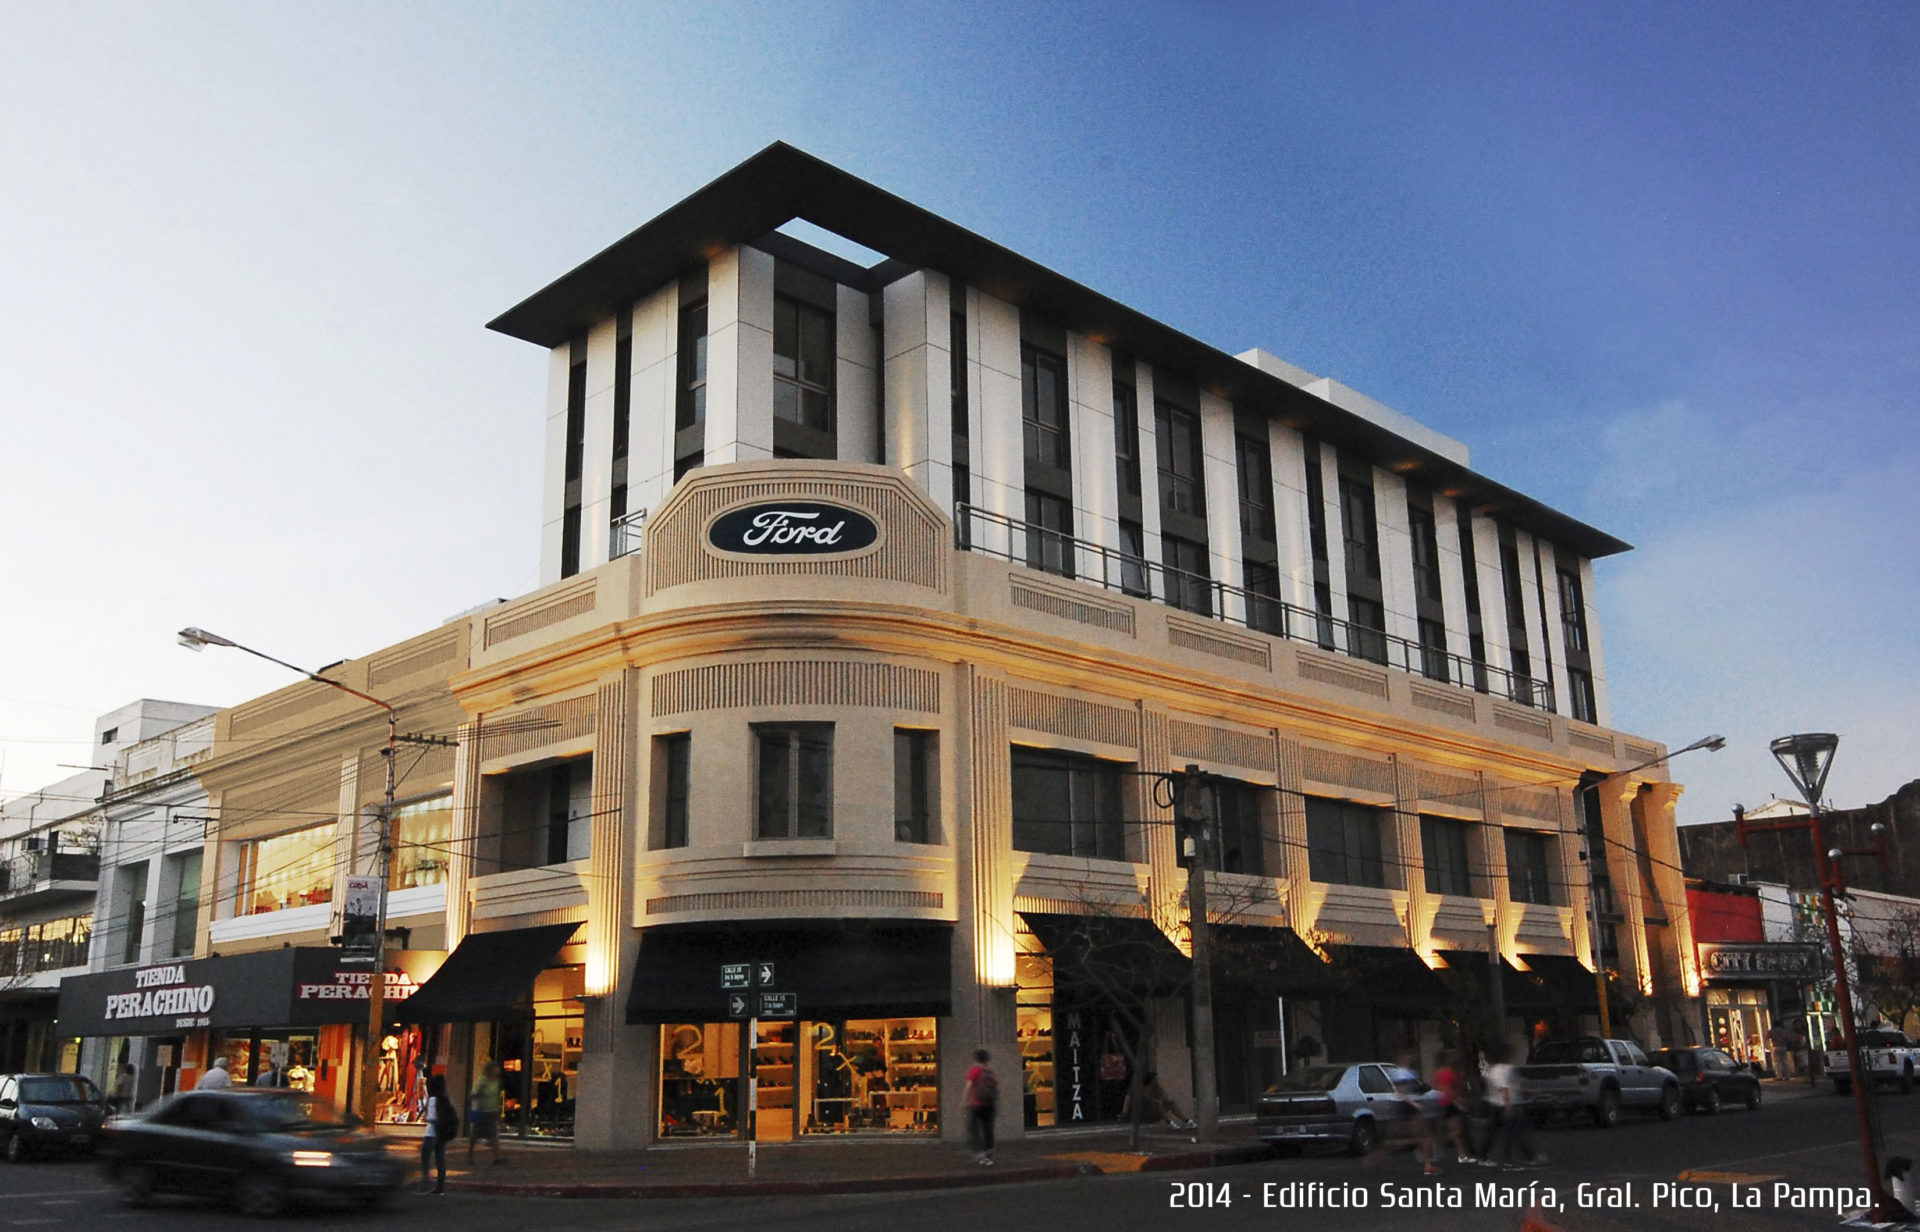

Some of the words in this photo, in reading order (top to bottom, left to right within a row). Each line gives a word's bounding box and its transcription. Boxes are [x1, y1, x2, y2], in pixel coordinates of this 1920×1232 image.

[743, 511, 845, 546] Ford
[1711, 951, 1751, 971] CITY
[135, 965, 185, 988] TIENDA
[335, 973, 412, 985] TIEDA
[105, 985, 215, 1019] PERACHINO
[1067, 1012, 1083, 1120] MAITZA
